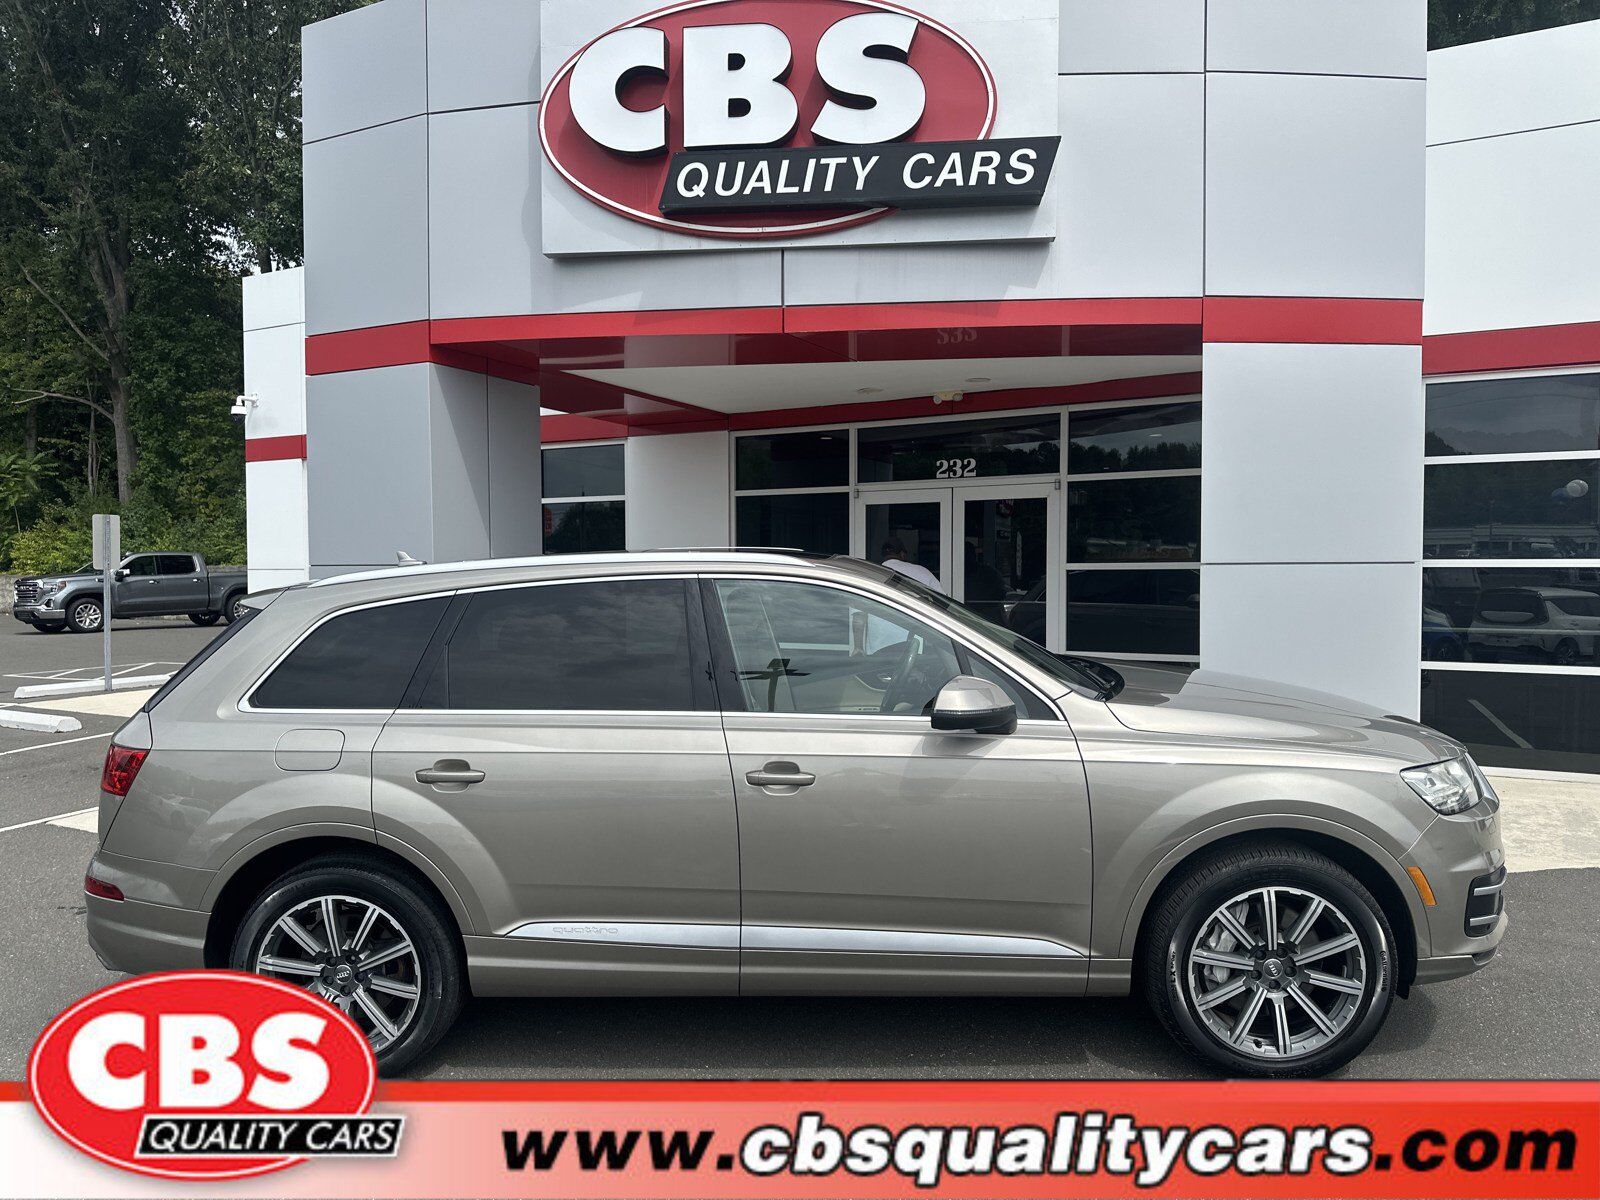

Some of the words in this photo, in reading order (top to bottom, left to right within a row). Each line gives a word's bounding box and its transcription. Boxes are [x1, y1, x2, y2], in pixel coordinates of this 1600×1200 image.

[569, 12, 926, 154] CBS
[676, 156, 879, 198] QUALITY
[902, 148, 1037, 190] CARS
[936, 458, 977, 479] 232
[552, 926, 618, 934] quattro
